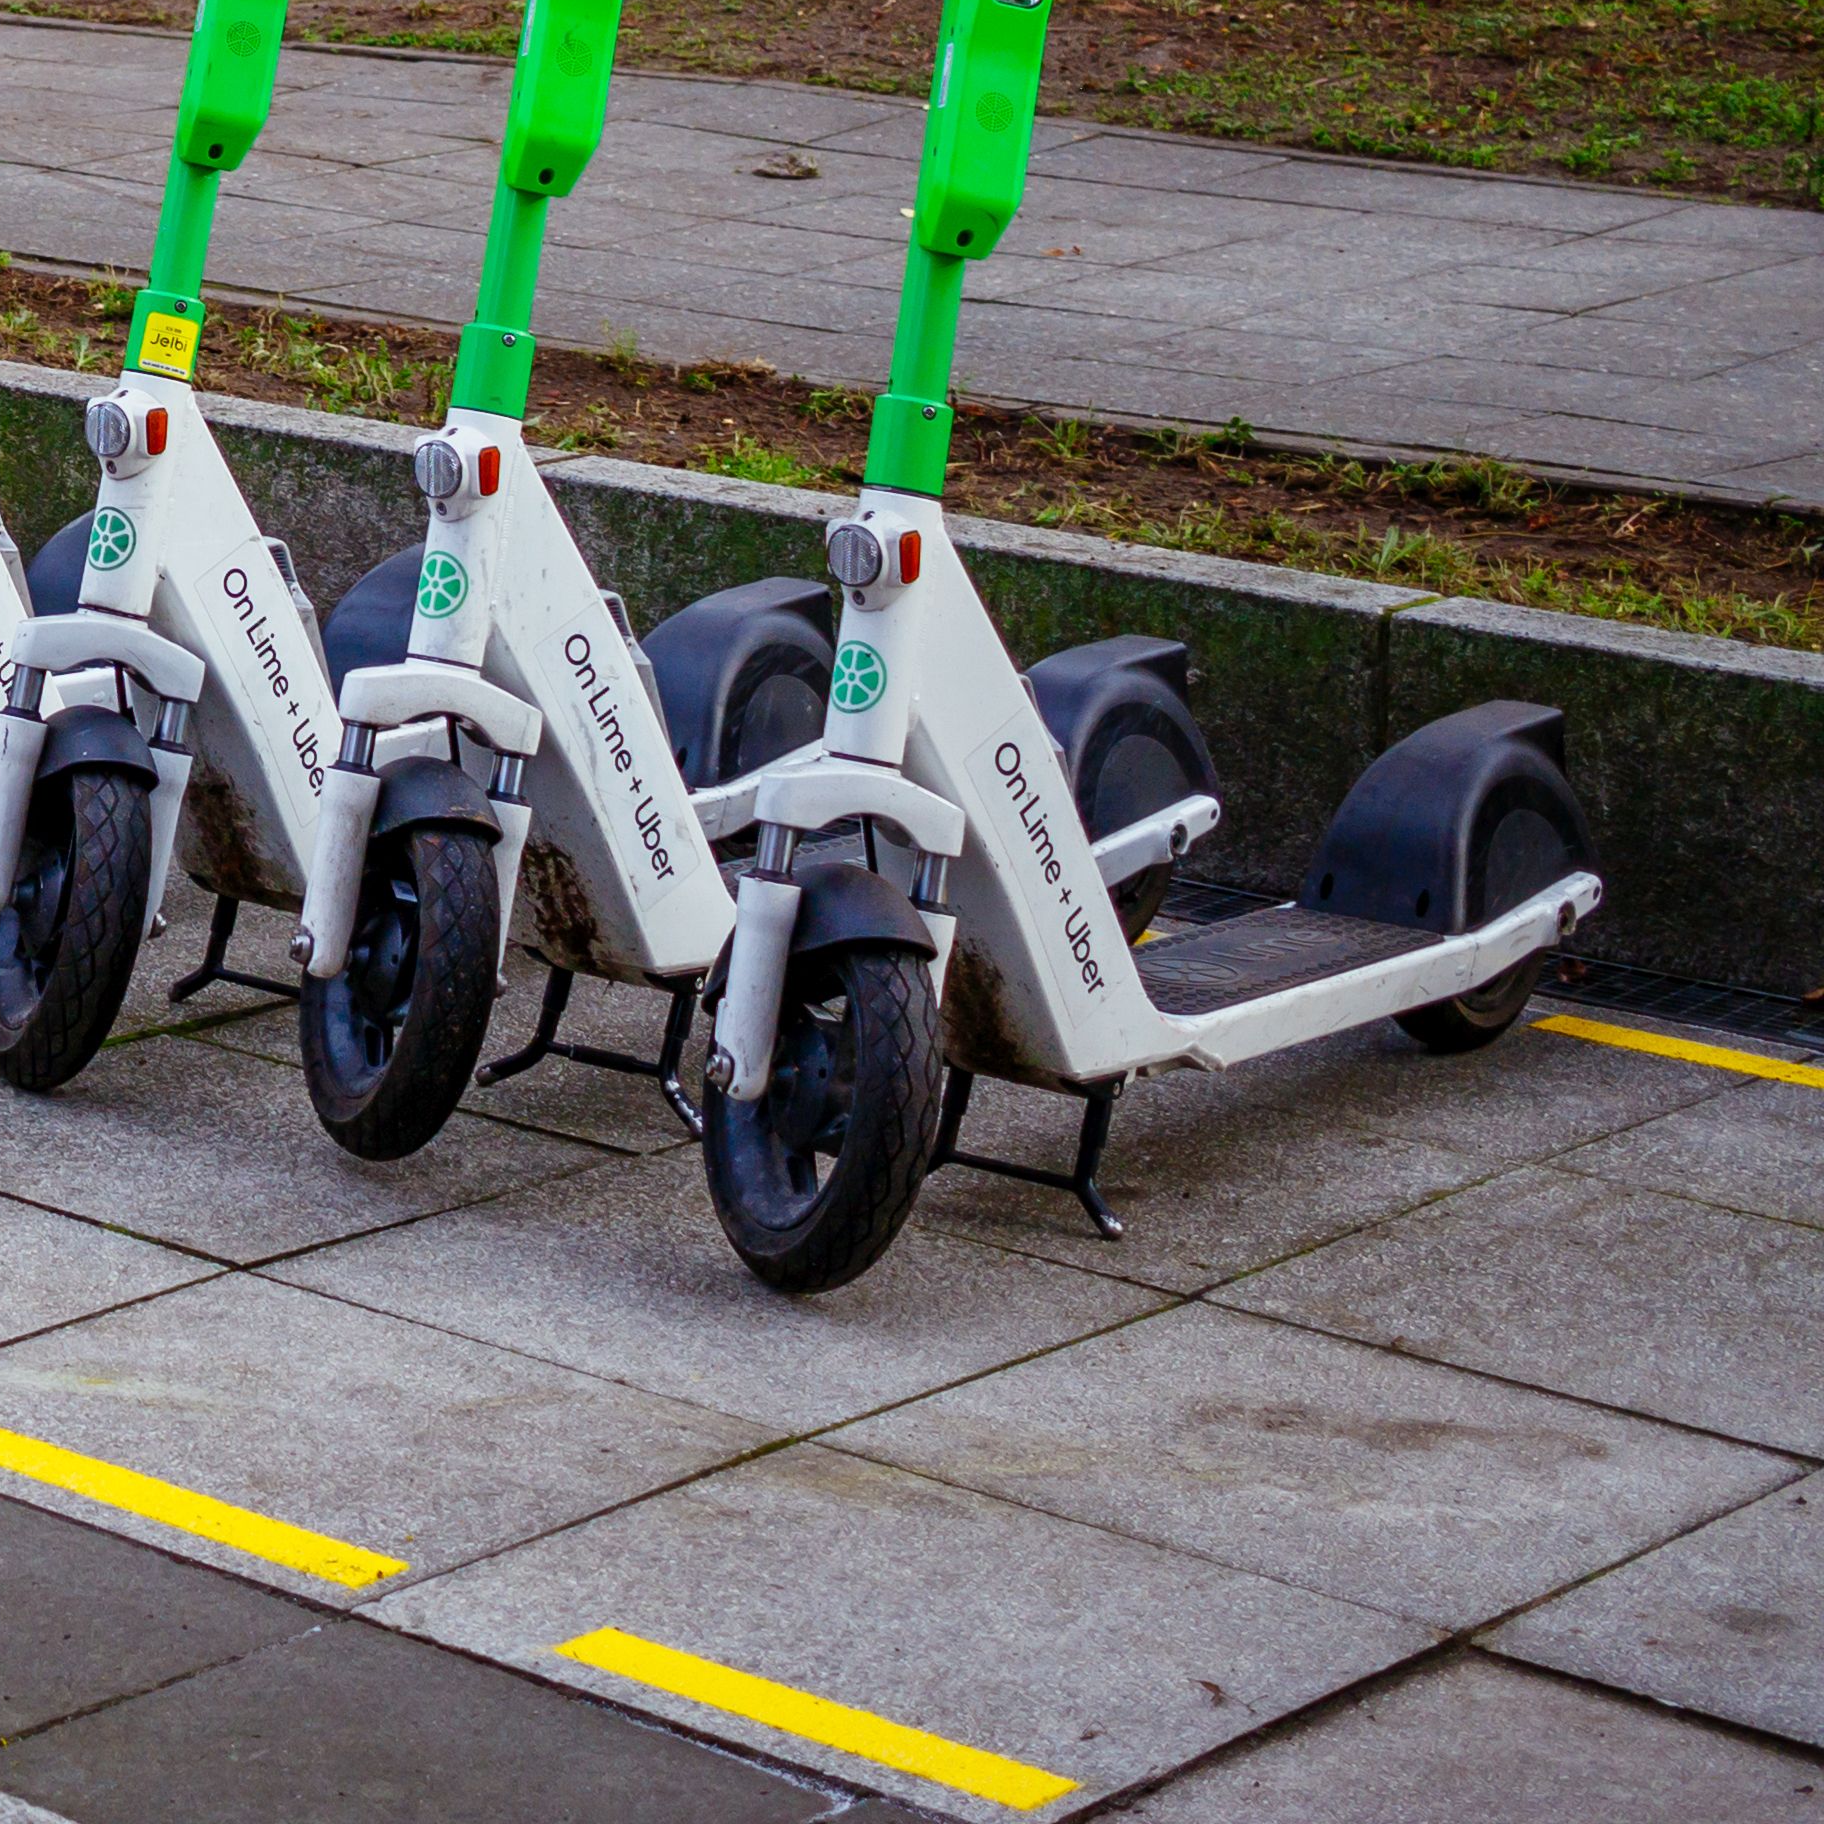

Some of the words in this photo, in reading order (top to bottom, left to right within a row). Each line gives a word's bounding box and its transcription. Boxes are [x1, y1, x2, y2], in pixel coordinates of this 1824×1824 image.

[150, 333, 188, 353] Jelbi
[223, 568, 254, 621] On
[246, 616, 289, 698] Lime
[287, 700, 300, 717] +
[564, 633, 596, 690] On
[588, 686, 632, 774] Lime
[629, 776, 642, 794] +
[995, 742, 1027, 801] On
[635, 795, 675, 880] Uber
[1019, 794, 1061, 885] Lime
[1058, 887, 1073, 905] +
[1065, 906, 1105, 994] Uber
